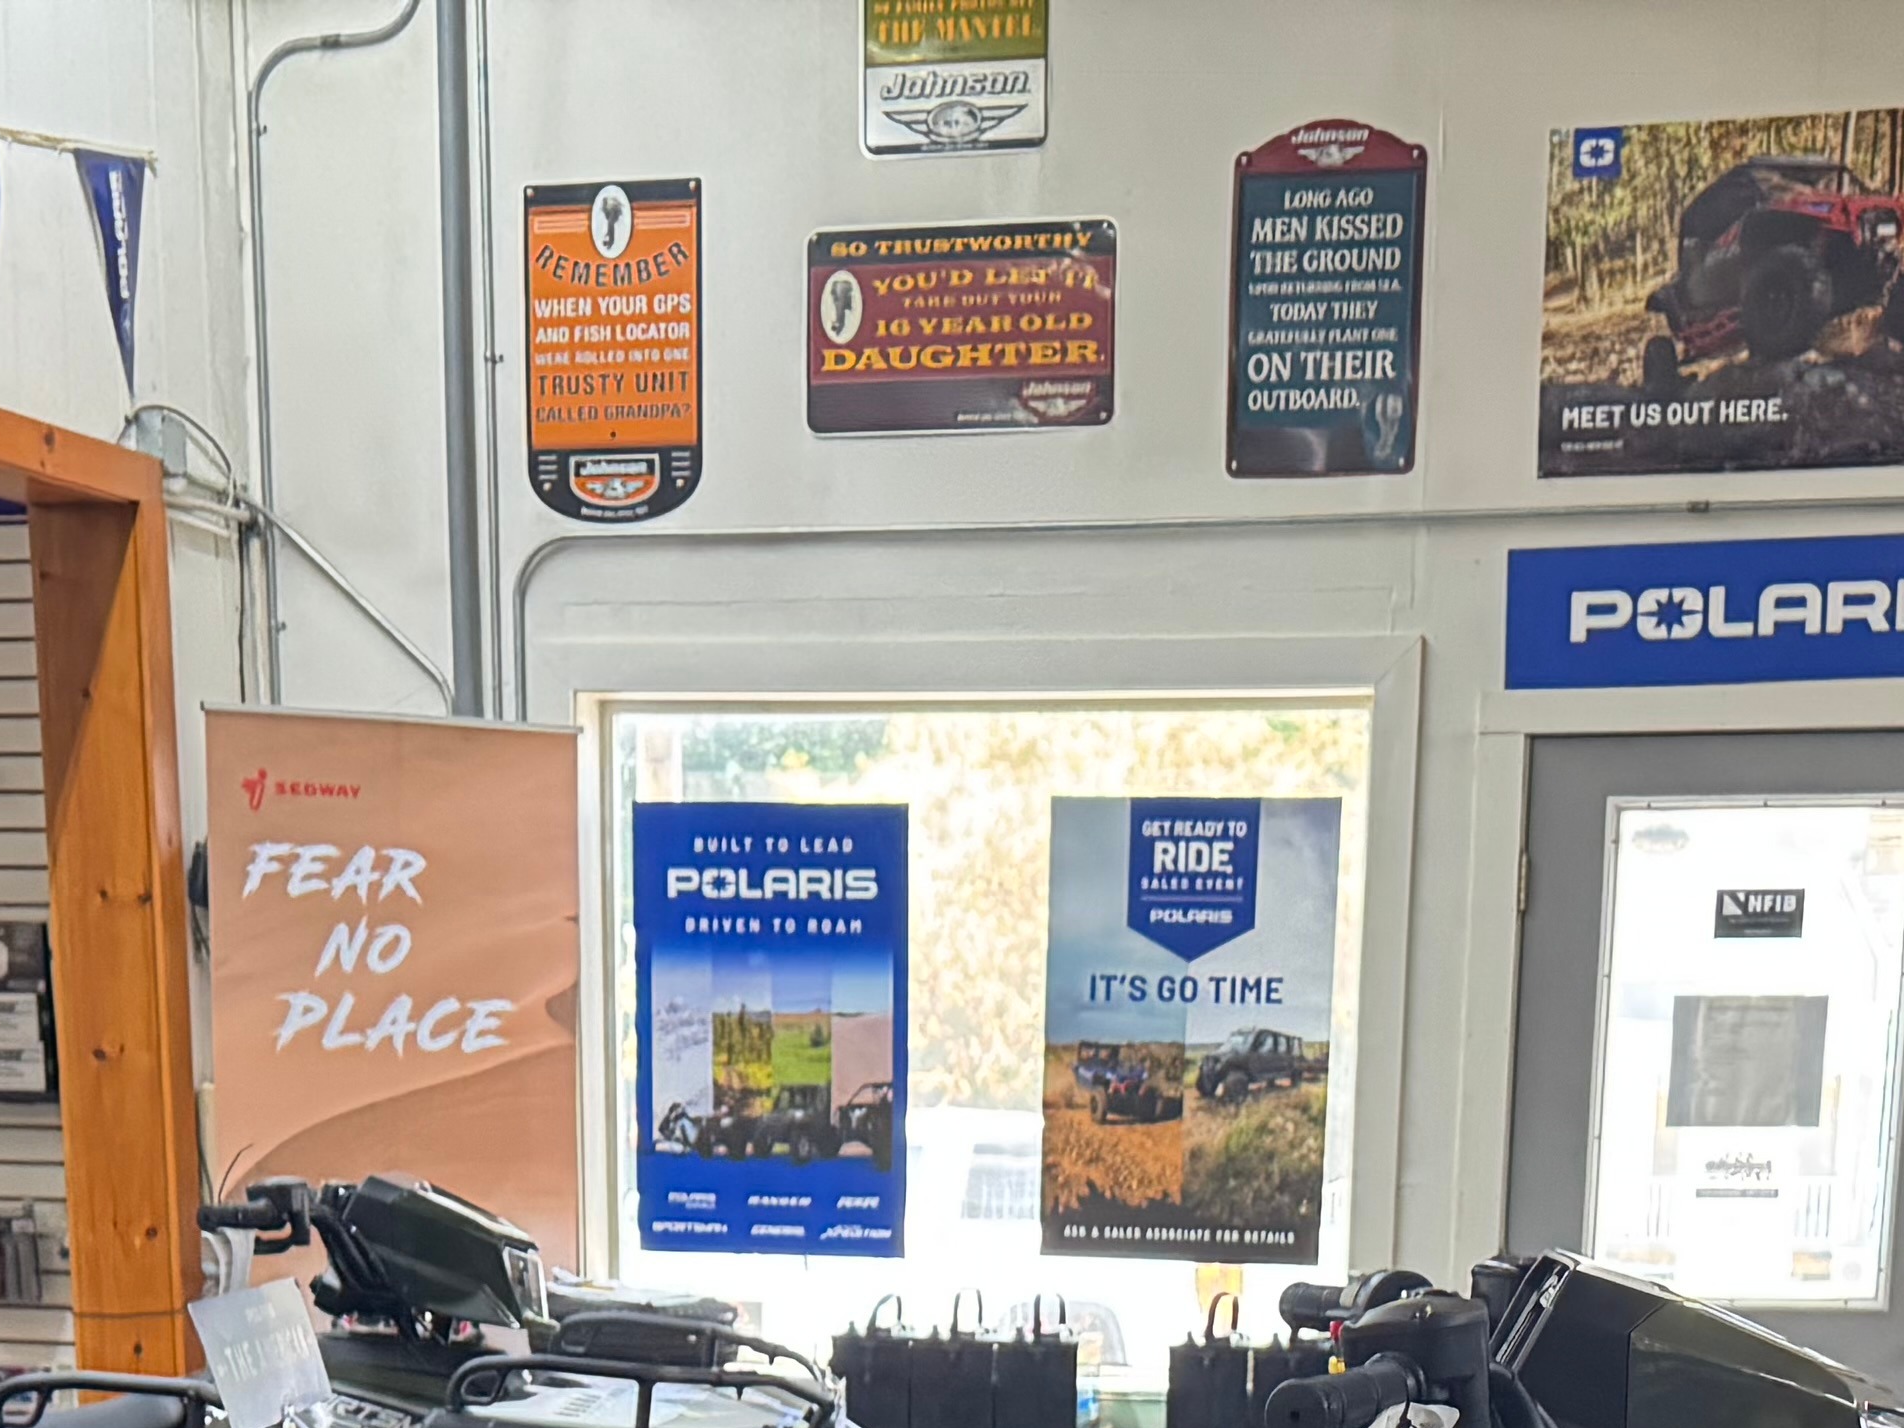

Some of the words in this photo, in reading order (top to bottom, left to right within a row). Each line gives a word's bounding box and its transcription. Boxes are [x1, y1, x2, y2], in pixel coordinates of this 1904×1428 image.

[880, 70, 1031, 100] Johnson
[1284, 189, 1332, 210] LONG
[1336, 187, 1374, 208] AGO
[107, 170, 130, 299] POLARIS
[1251, 216, 1308, 244] MEN
[1315, 213, 1404, 241] KISSED
[830, 241, 867, 258] SO
[874, 232, 1092, 256] TRUSTWORTHY
[535, 240, 690, 288] REMEMBER
[1250, 250, 1298, 274] THE
[1303, 247, 1402, 273] GROUND
[534, 297, 592, 319] WHEN
[598, 294, 647, 316] YOUR
[653, 292, 692, 314] GPS
[1270, 301, 1328, 322] TODAY
[1331, 300, 1378, 321] THEY
[536, 324, 569, 344] AND
[574, 323, 612, 342] FISH
[616, 321, 690, 341] LOCATOR
[919, 315, 1014, 335] YEAR
[1019, 312, 1093, 331] OLD
[1247, 352, 1292, 383] ON
[1300, 349, 1396, 381] THEIR
[537, 373, 625, 397] TRUSTY
[635, 371, 689, 393] UNIT
[536, 404, 599, 422] CALLED
[604, 402, 692, 421] GRANDPA?
[1247, 388, 1361, 412] OUTBOARD.
[1561, 403, 1625, 431] MEET
[1629, 401, 1662, 427] US
[1667, 400, 1712, 426] OUT
[1718, 396, 1789, 424] HERE.
[274, 781, 361, 799] SEGWAY
[1142, 820, 1171, 837] GET
[1174, 820, 1224, 837] READY
[1228, 821, 1248, 838] TO
[694, 836, 754, 854] BUILT
[765, 837, 789, 853] TO
[1153, 840, 1234, 874] RIDE
[242, 841, 427, 906] FEAR
[667, 867, 878, 900] POLARIS
[773, 918, 796, 934] TO
[1150, 908, 1233, 924] POLARIS
[314, 914, 412, 980] NO
[1089, 974, 1147, 1003] IT'S
[1156, 975, 1197, 1001] GO
[1208, 977, 1284, 1005] TIME
[274, 988, 518, 1060] PLACE
